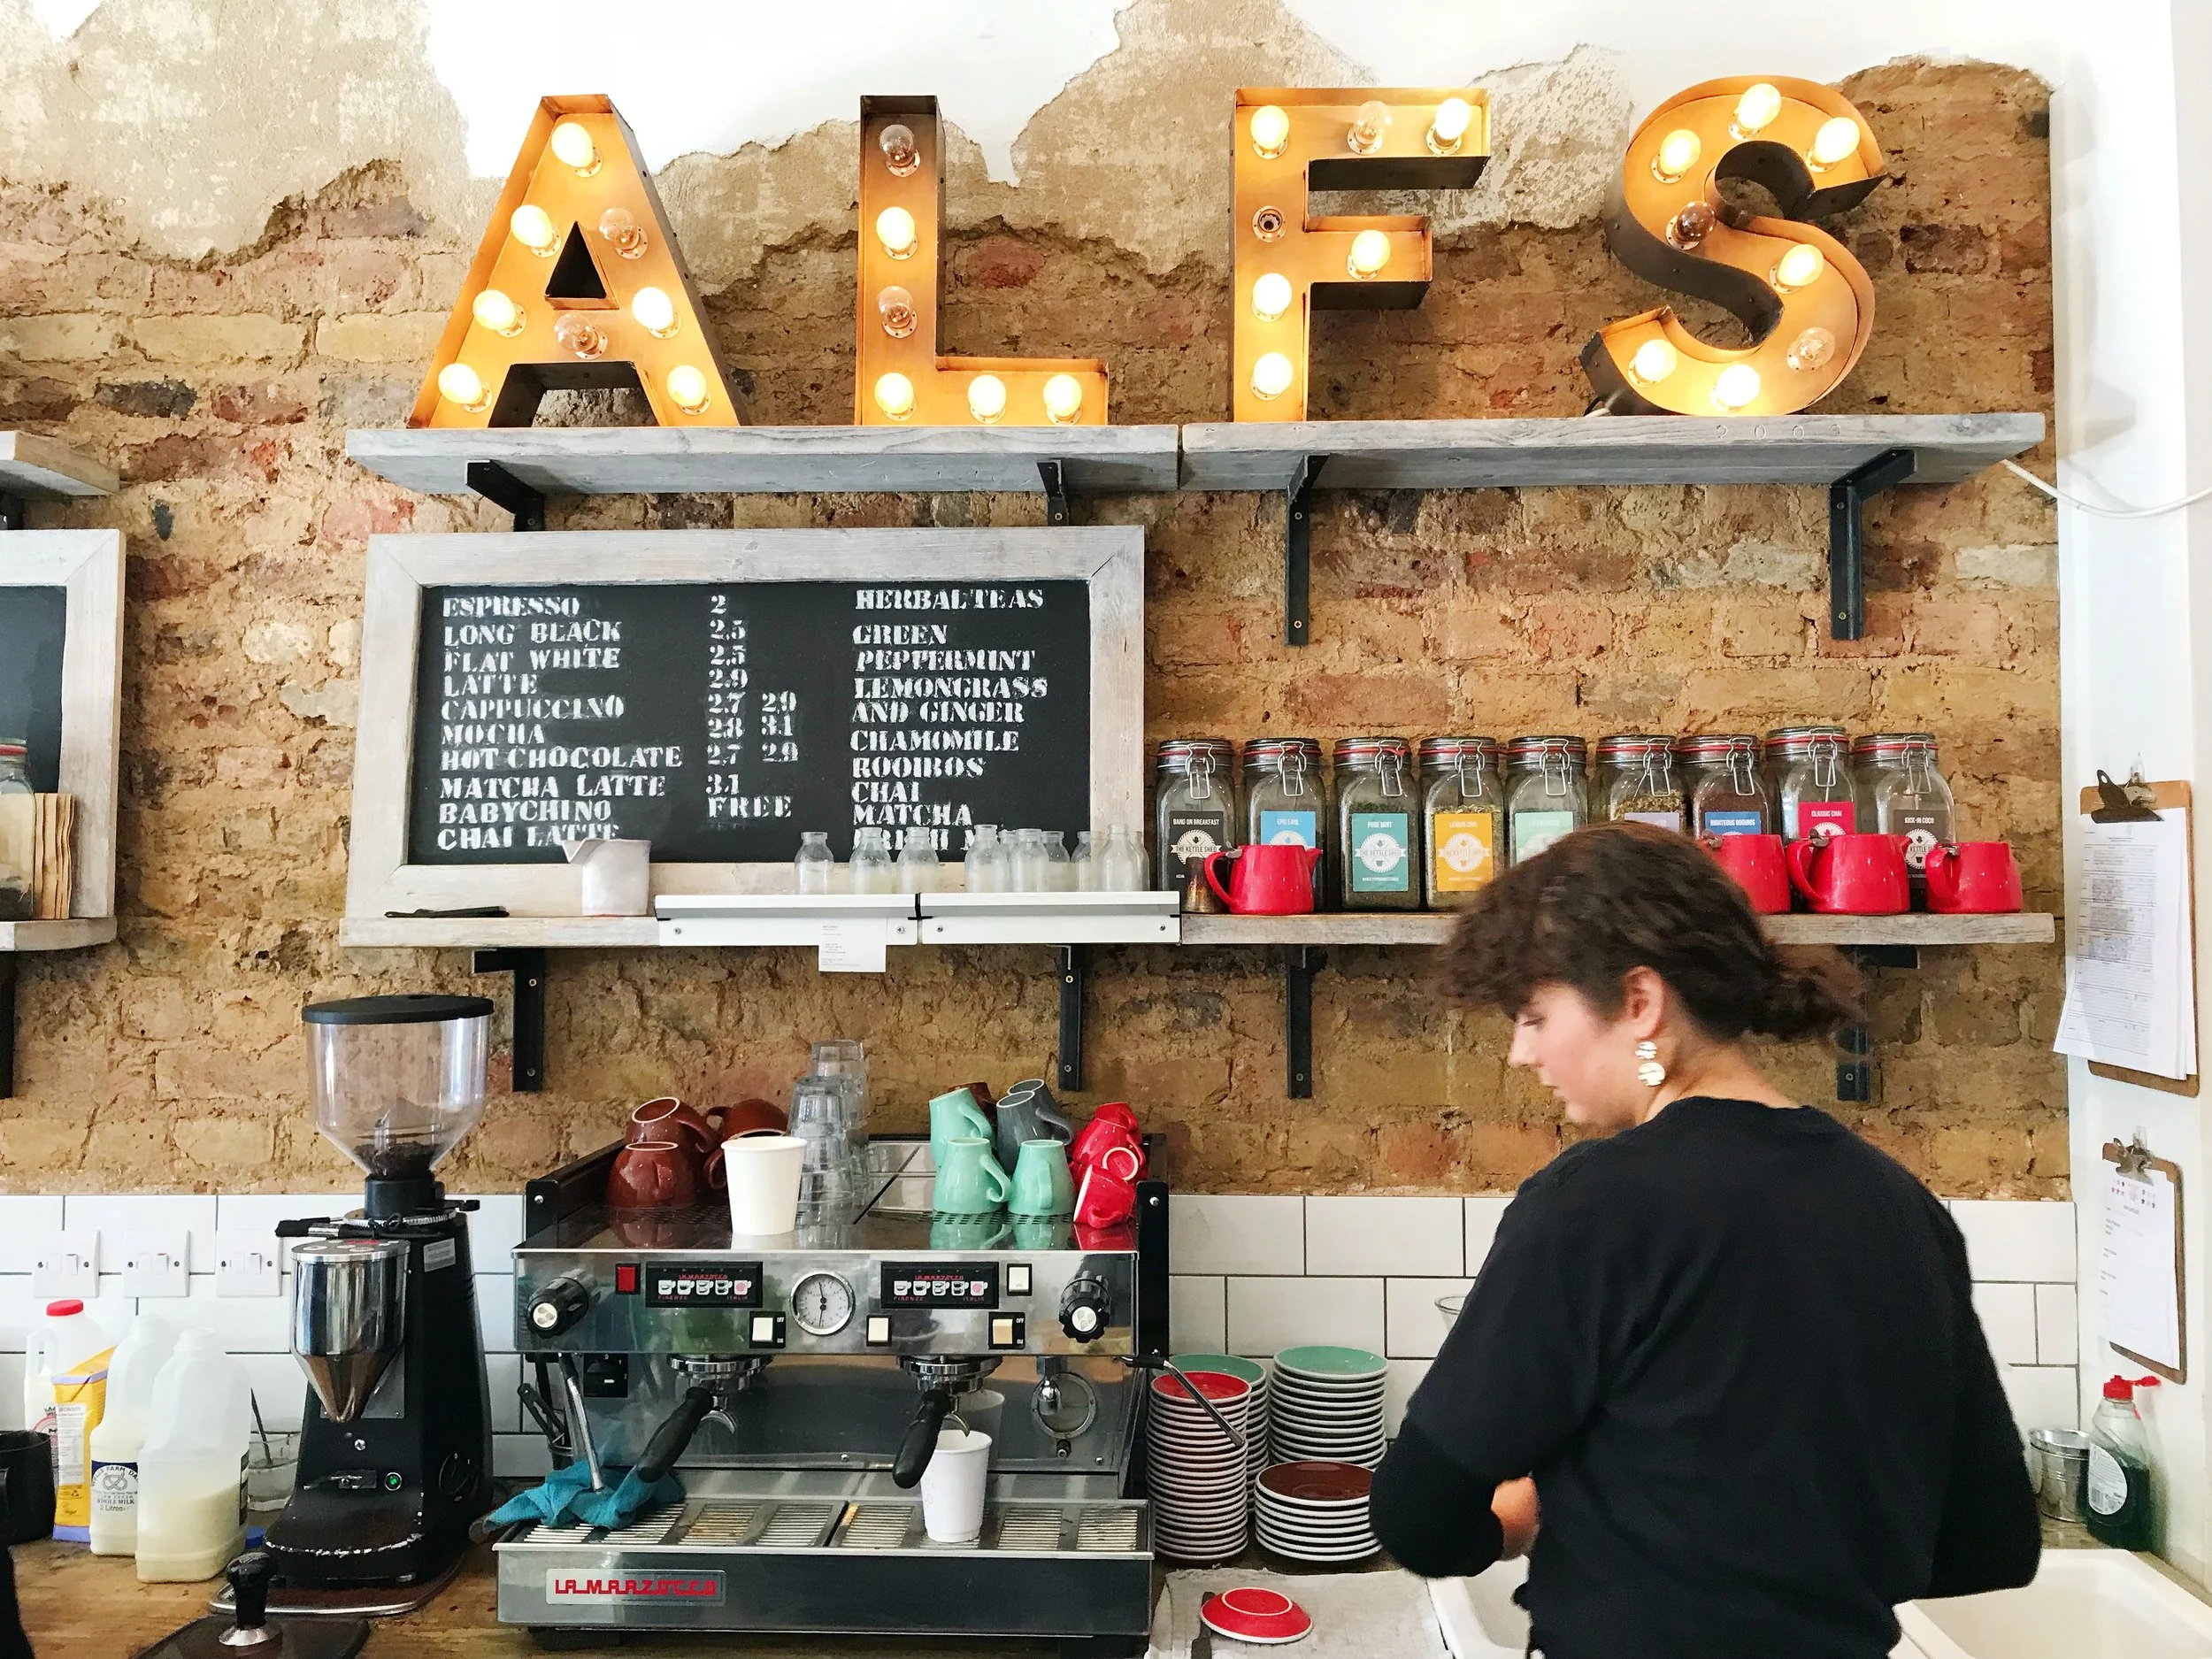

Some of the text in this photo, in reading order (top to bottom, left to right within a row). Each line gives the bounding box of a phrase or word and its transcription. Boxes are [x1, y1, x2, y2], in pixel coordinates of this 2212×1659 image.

[406, 73, 1891, 427] ALFS
[442, 595, 726, 618] ESPRESSO 2
[855, 588, 1044, 610] HERBAL TEAS
[444, 619, 746, 646] LONG BLACK 2.5
[852, 624, 948, 646] GREEN
[444, 645, 746, 672] FLAT WHITE 2.5
[856, 649, 1036, 672] PEPPERMINT
[444, 674, 537, 696] LATTE
[854, 676, 1048, 699] LEMONGRASS
[442, 695, 625, 720] CAPPUCCINO
[851, 702, 1025, 724] AND GINGER
[442, 724, 546, 745] MOCHA
[761, 714, 793, 736] 3.1
[850, 730, 1019, 752] CHAMOMILE
[442, 748, 498, 771] HOT
[507, 746, 682, 769] CHOCOLATE
[852, 757, 987, 779] ROOIBOS
[441, 773, 739, 799] MATCHA LATTE 3.1
[851, 781, 920, 803] CHAI
[439, 795, 792, 824] BABYCHINO FREE
[853, 803, 973, 826] MATCHA
[437, 826, 513, 850] CHAI
[556, 1579, 577, 1594] LA
